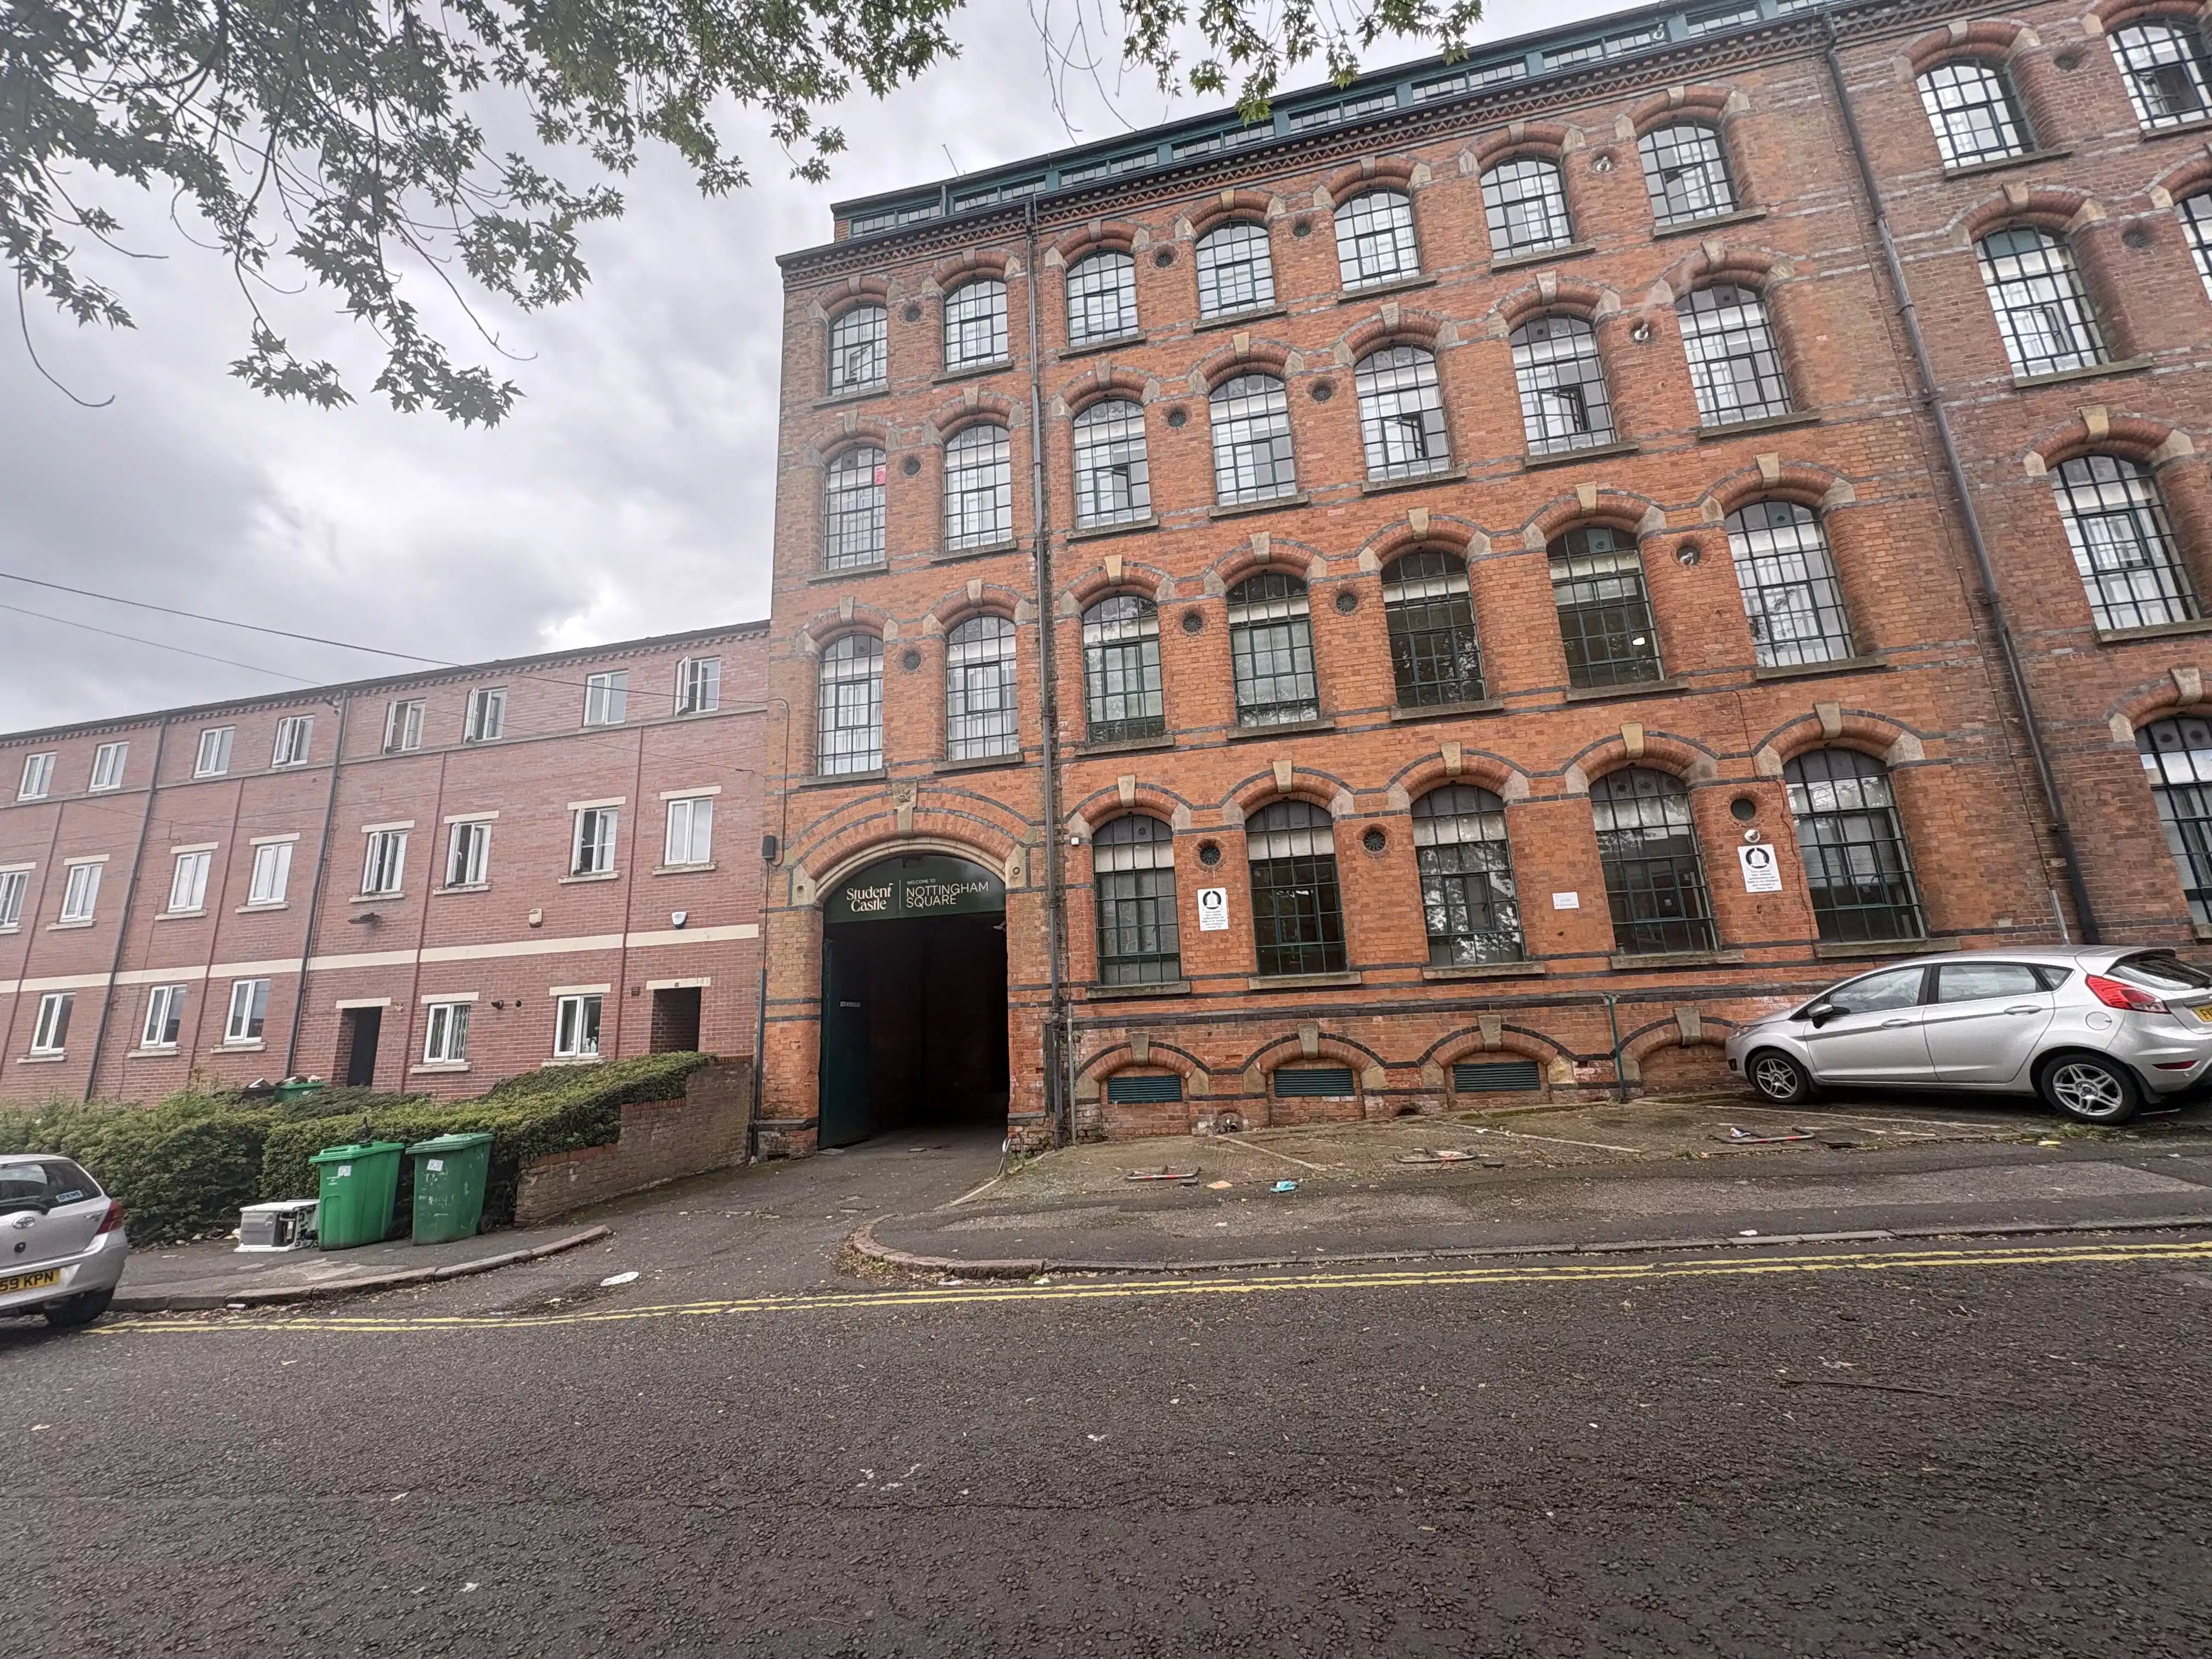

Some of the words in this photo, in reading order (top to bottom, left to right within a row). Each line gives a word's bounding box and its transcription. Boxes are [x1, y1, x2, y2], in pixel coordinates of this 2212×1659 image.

[847, 885, 892, 900] Student
[906, 881, 989, 898] NOTTINGHAM
[851, 898, 887, 912] Castle
[906, 895, 956, 910] SQUARE
[24, 1271, 53, 1288] KPN
